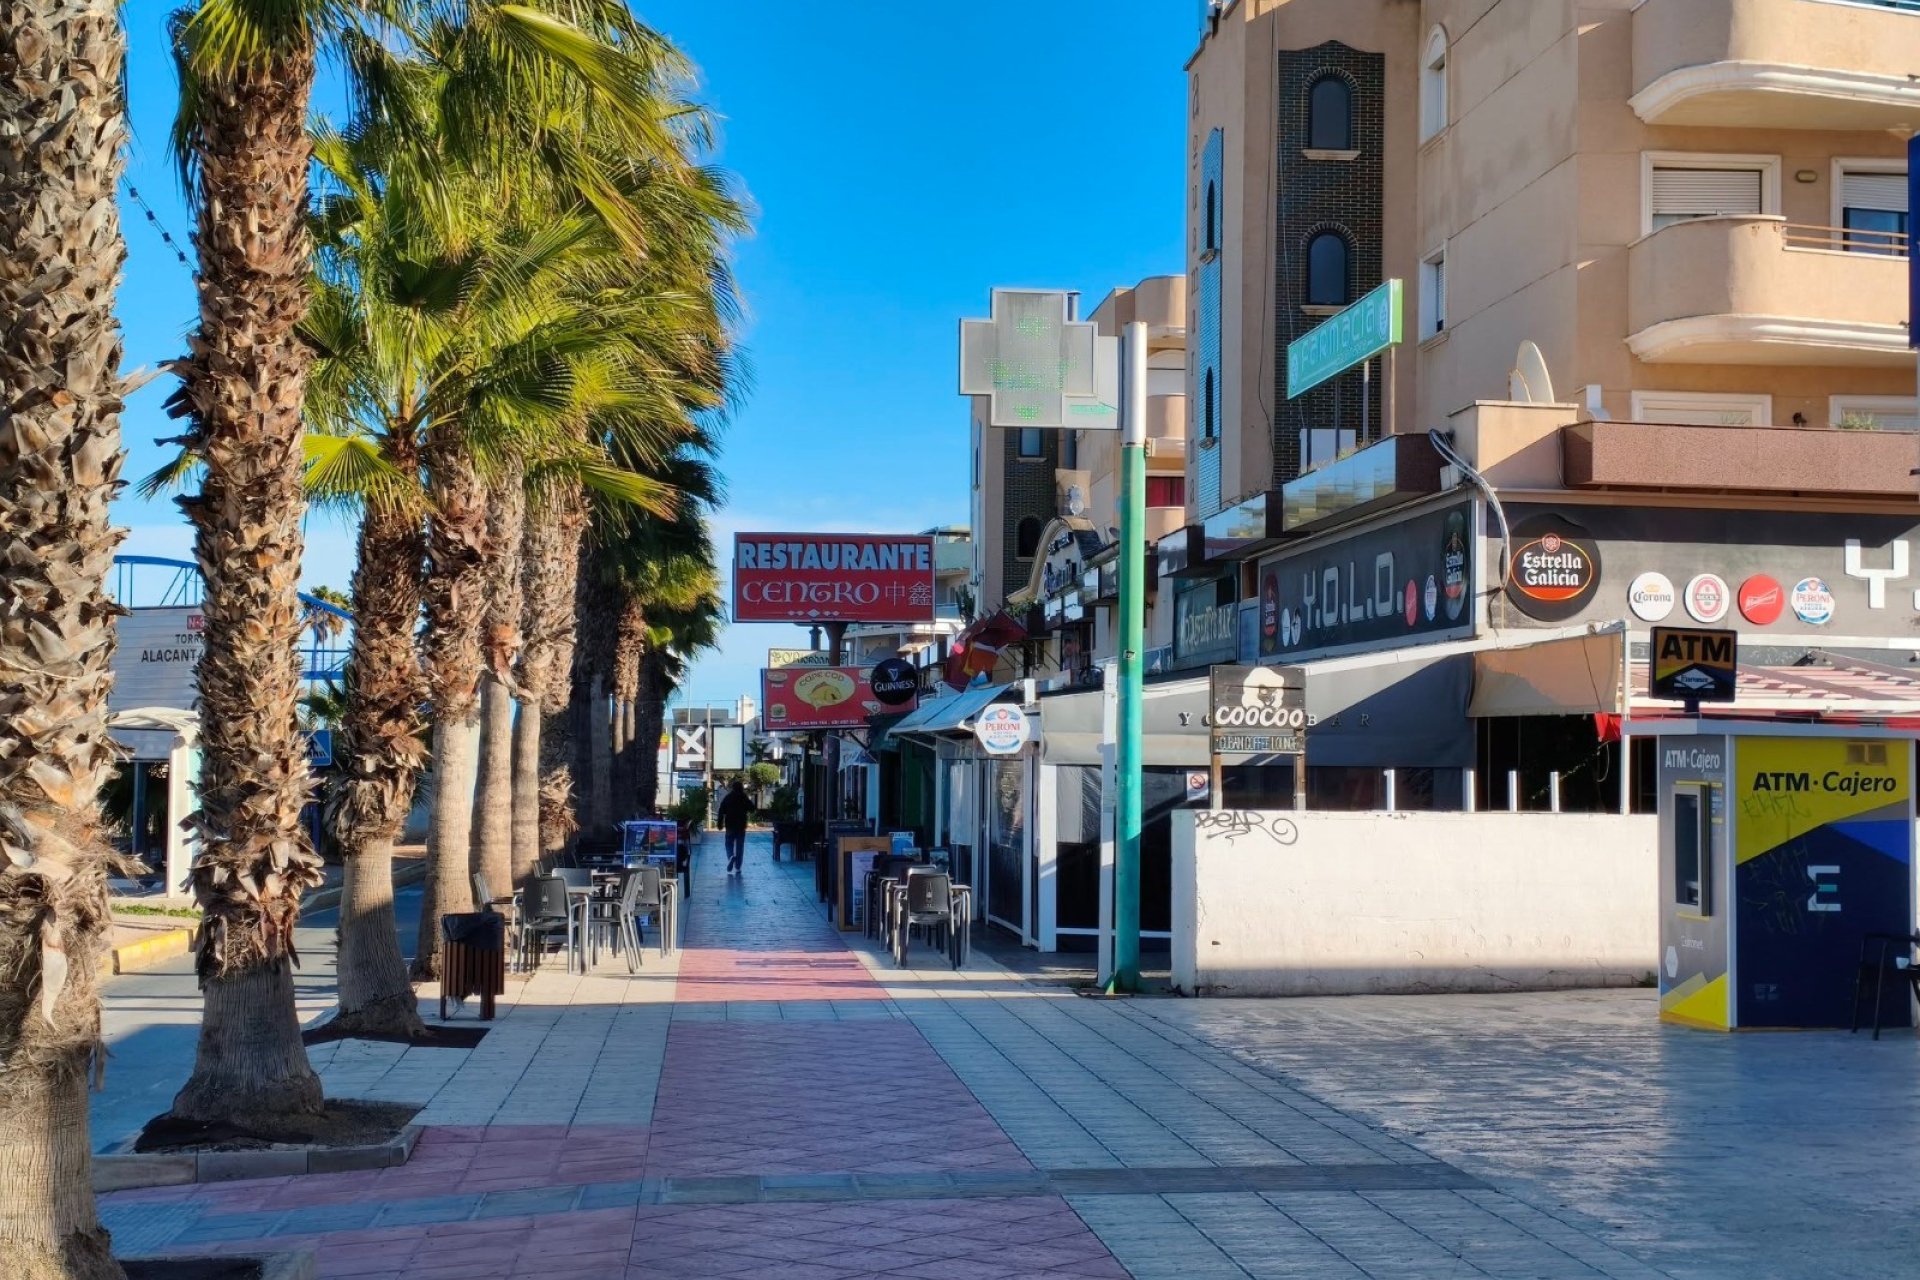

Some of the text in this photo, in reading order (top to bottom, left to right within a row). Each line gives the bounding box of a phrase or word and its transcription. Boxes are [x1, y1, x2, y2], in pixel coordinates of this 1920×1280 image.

[739, 542, 930, 570] RESTAURANTE
[1522, 552, 1582, 569] Estrella
[1525, 569, 1579, 586] Galicia
[742, 579, 880, 605] CENTRO
[1633, 591, 1672, 604] Corona
[1796, 593, 1829, 603] PERONI
[1661, 634, 1730, 662] ATM
[875, 680, 915, 693] GUINNESS
[1215, 705, 1304, 727] COOCOO
[985, 722, 1020, 732] PERONI
